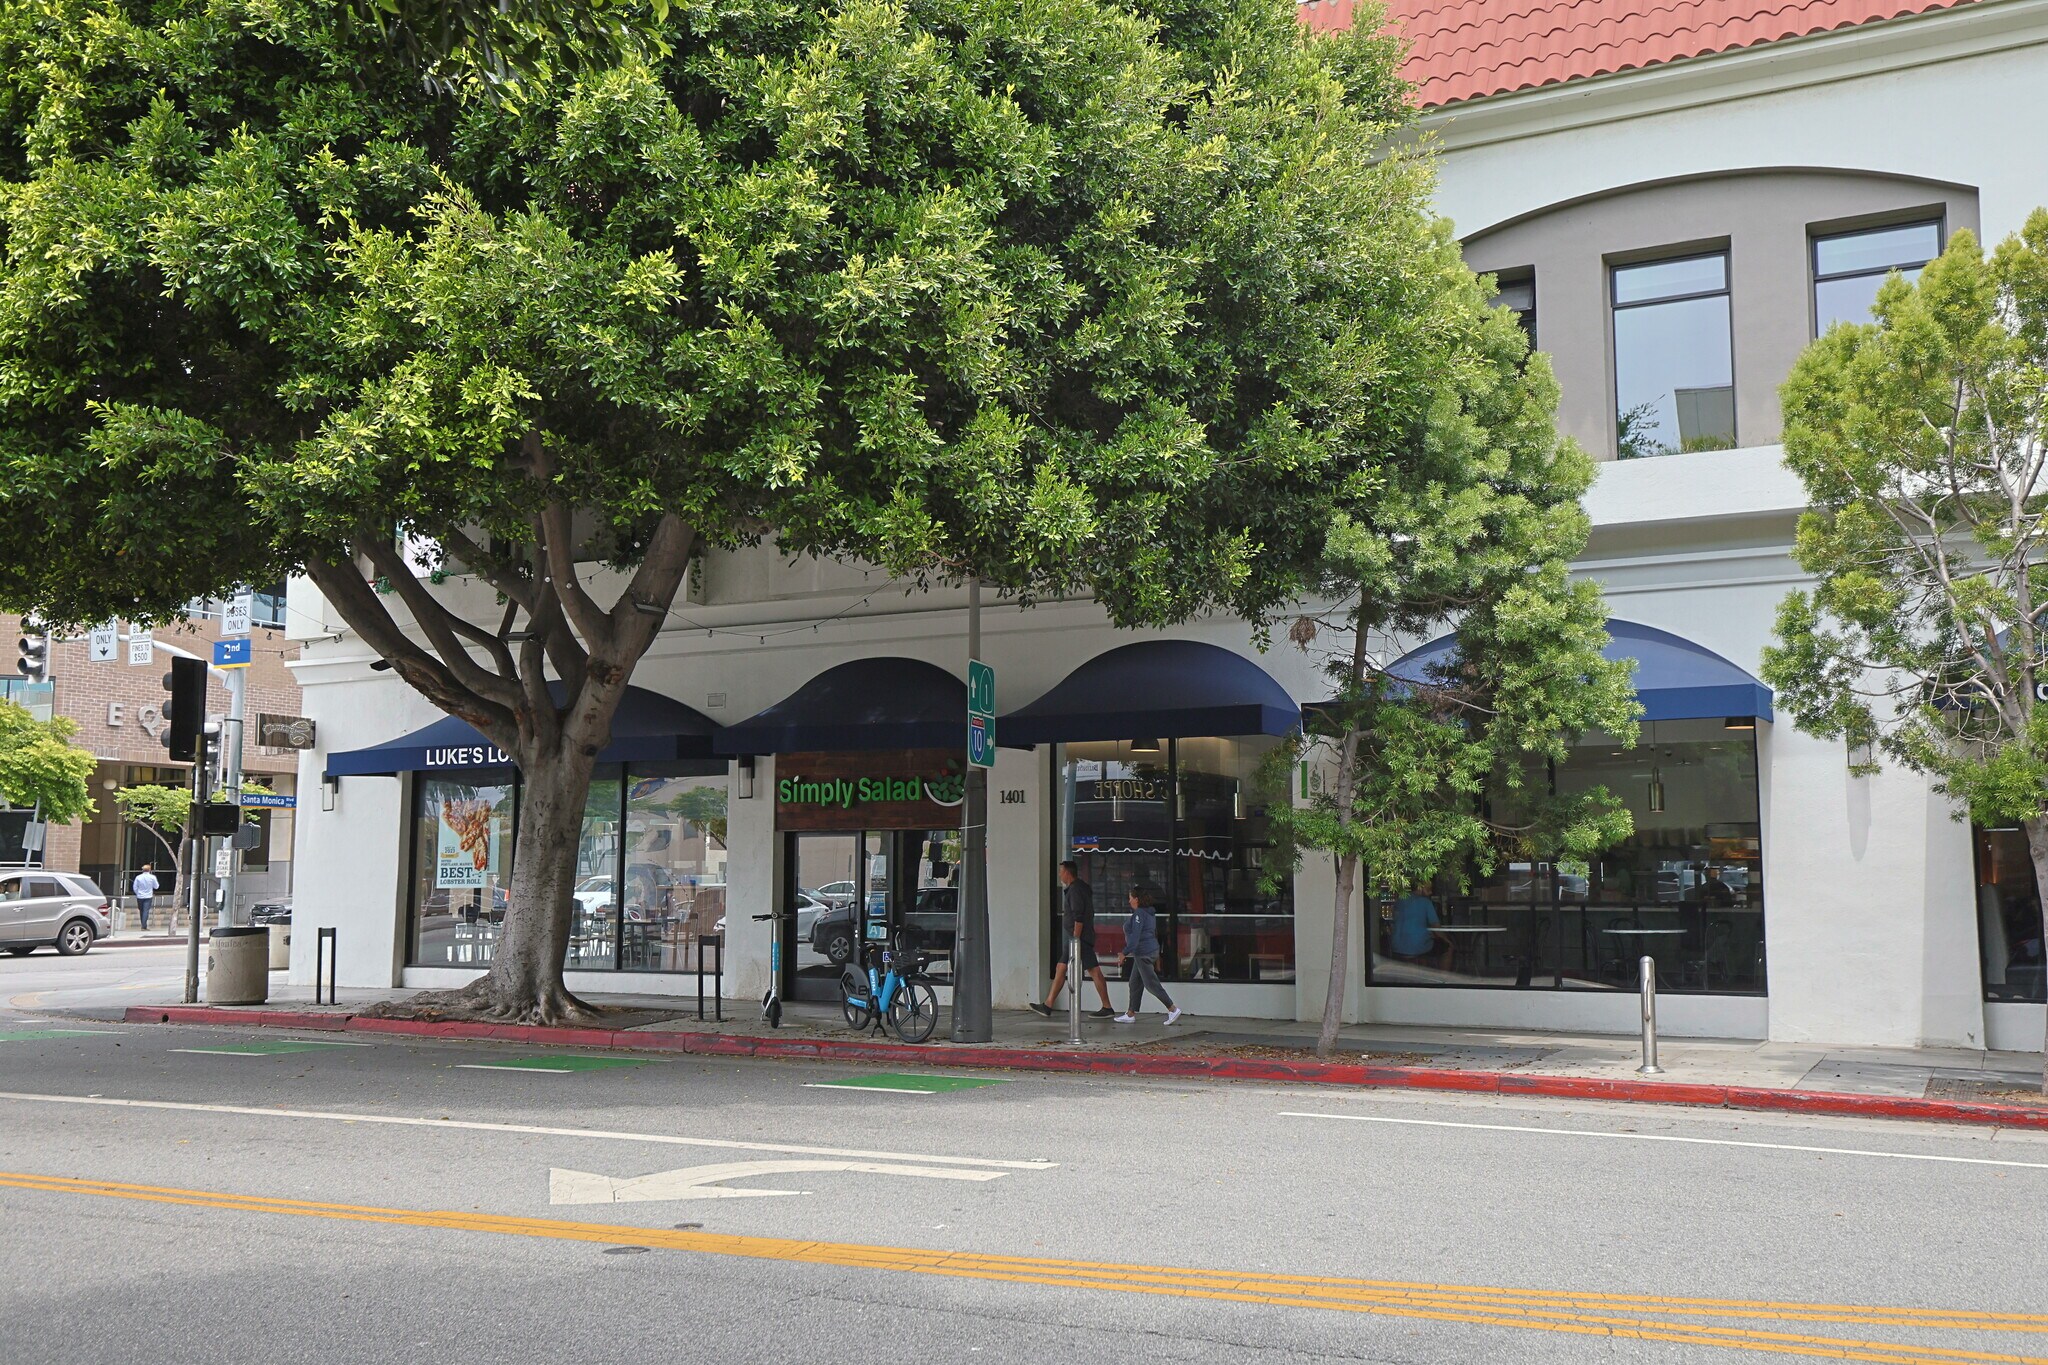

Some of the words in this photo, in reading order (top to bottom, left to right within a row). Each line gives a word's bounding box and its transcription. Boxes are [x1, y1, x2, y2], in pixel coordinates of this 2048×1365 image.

[227, 619, 245, 631] ONLY
[95, 634, 112, 645] ONLY
[131, 644, 144, 652] FINES
[223, 643, 241, 660] 2nd
[134, 652, 148, 662] $500
[973, 729, 983, 752] 10
[426, 746, 484, 766] LUKE'S
[488, 746, 514, 763] LO
[779, 775, 854, 809] Simply
[858, 775, 921, 802] Salad
[1000, 790, 1026, 804] 1401
[242, 795, 261, 804] Santa
[261, 796, 285, 805] Monica
[440, 867, 473, 878] BEST
[869, 925, 878, 935] A
